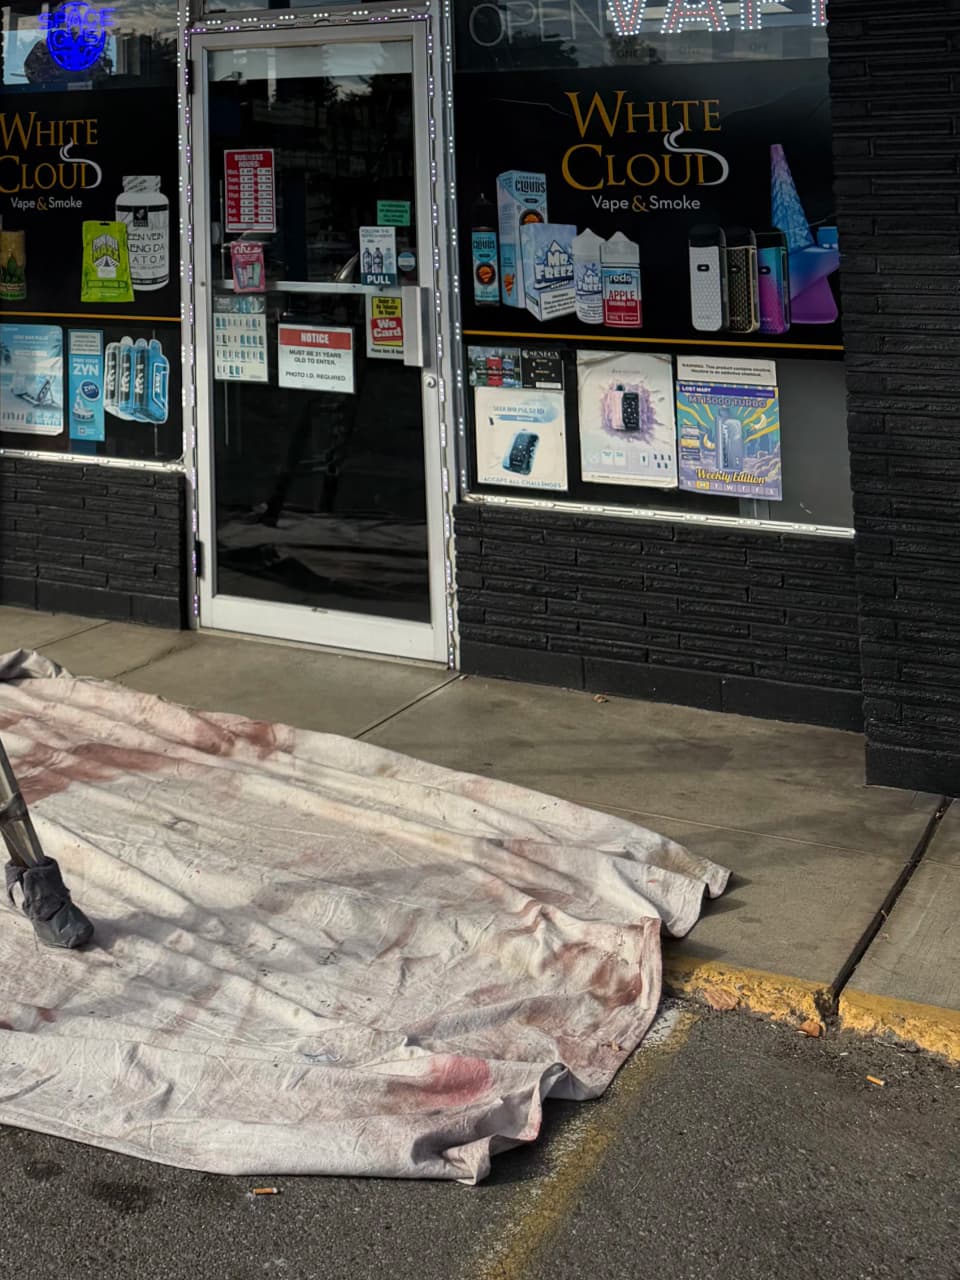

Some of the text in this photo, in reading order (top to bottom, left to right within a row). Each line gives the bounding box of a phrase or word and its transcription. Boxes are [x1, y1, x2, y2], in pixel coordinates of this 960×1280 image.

[564, 90, 722, 137] WHITE
[561, 143, 729, 191] CLOUD
[10, 197, 83, 210] Vape & Smoke
[591, 195, 701, 212] Vape & Smoke
[129, 244, 152, 253] ENG
[132, 255, 165, 264] ATOM
[535, 264, 574, 280] FREEZ
[366, 274, 391, 285] PULL
[608, 290, 635, 299] APPLE
[376, 318, 397, 328] We
[300, 331, 329, 344] NOTICE
[373, 327, 401, 337] Card
[72, 363, 99, 376] ZYN
[316, 373, 346, 381] REQUIRED
[732, 398, 767, 408] TURBO
[695, 468, 766, 486] Weekly Edition
